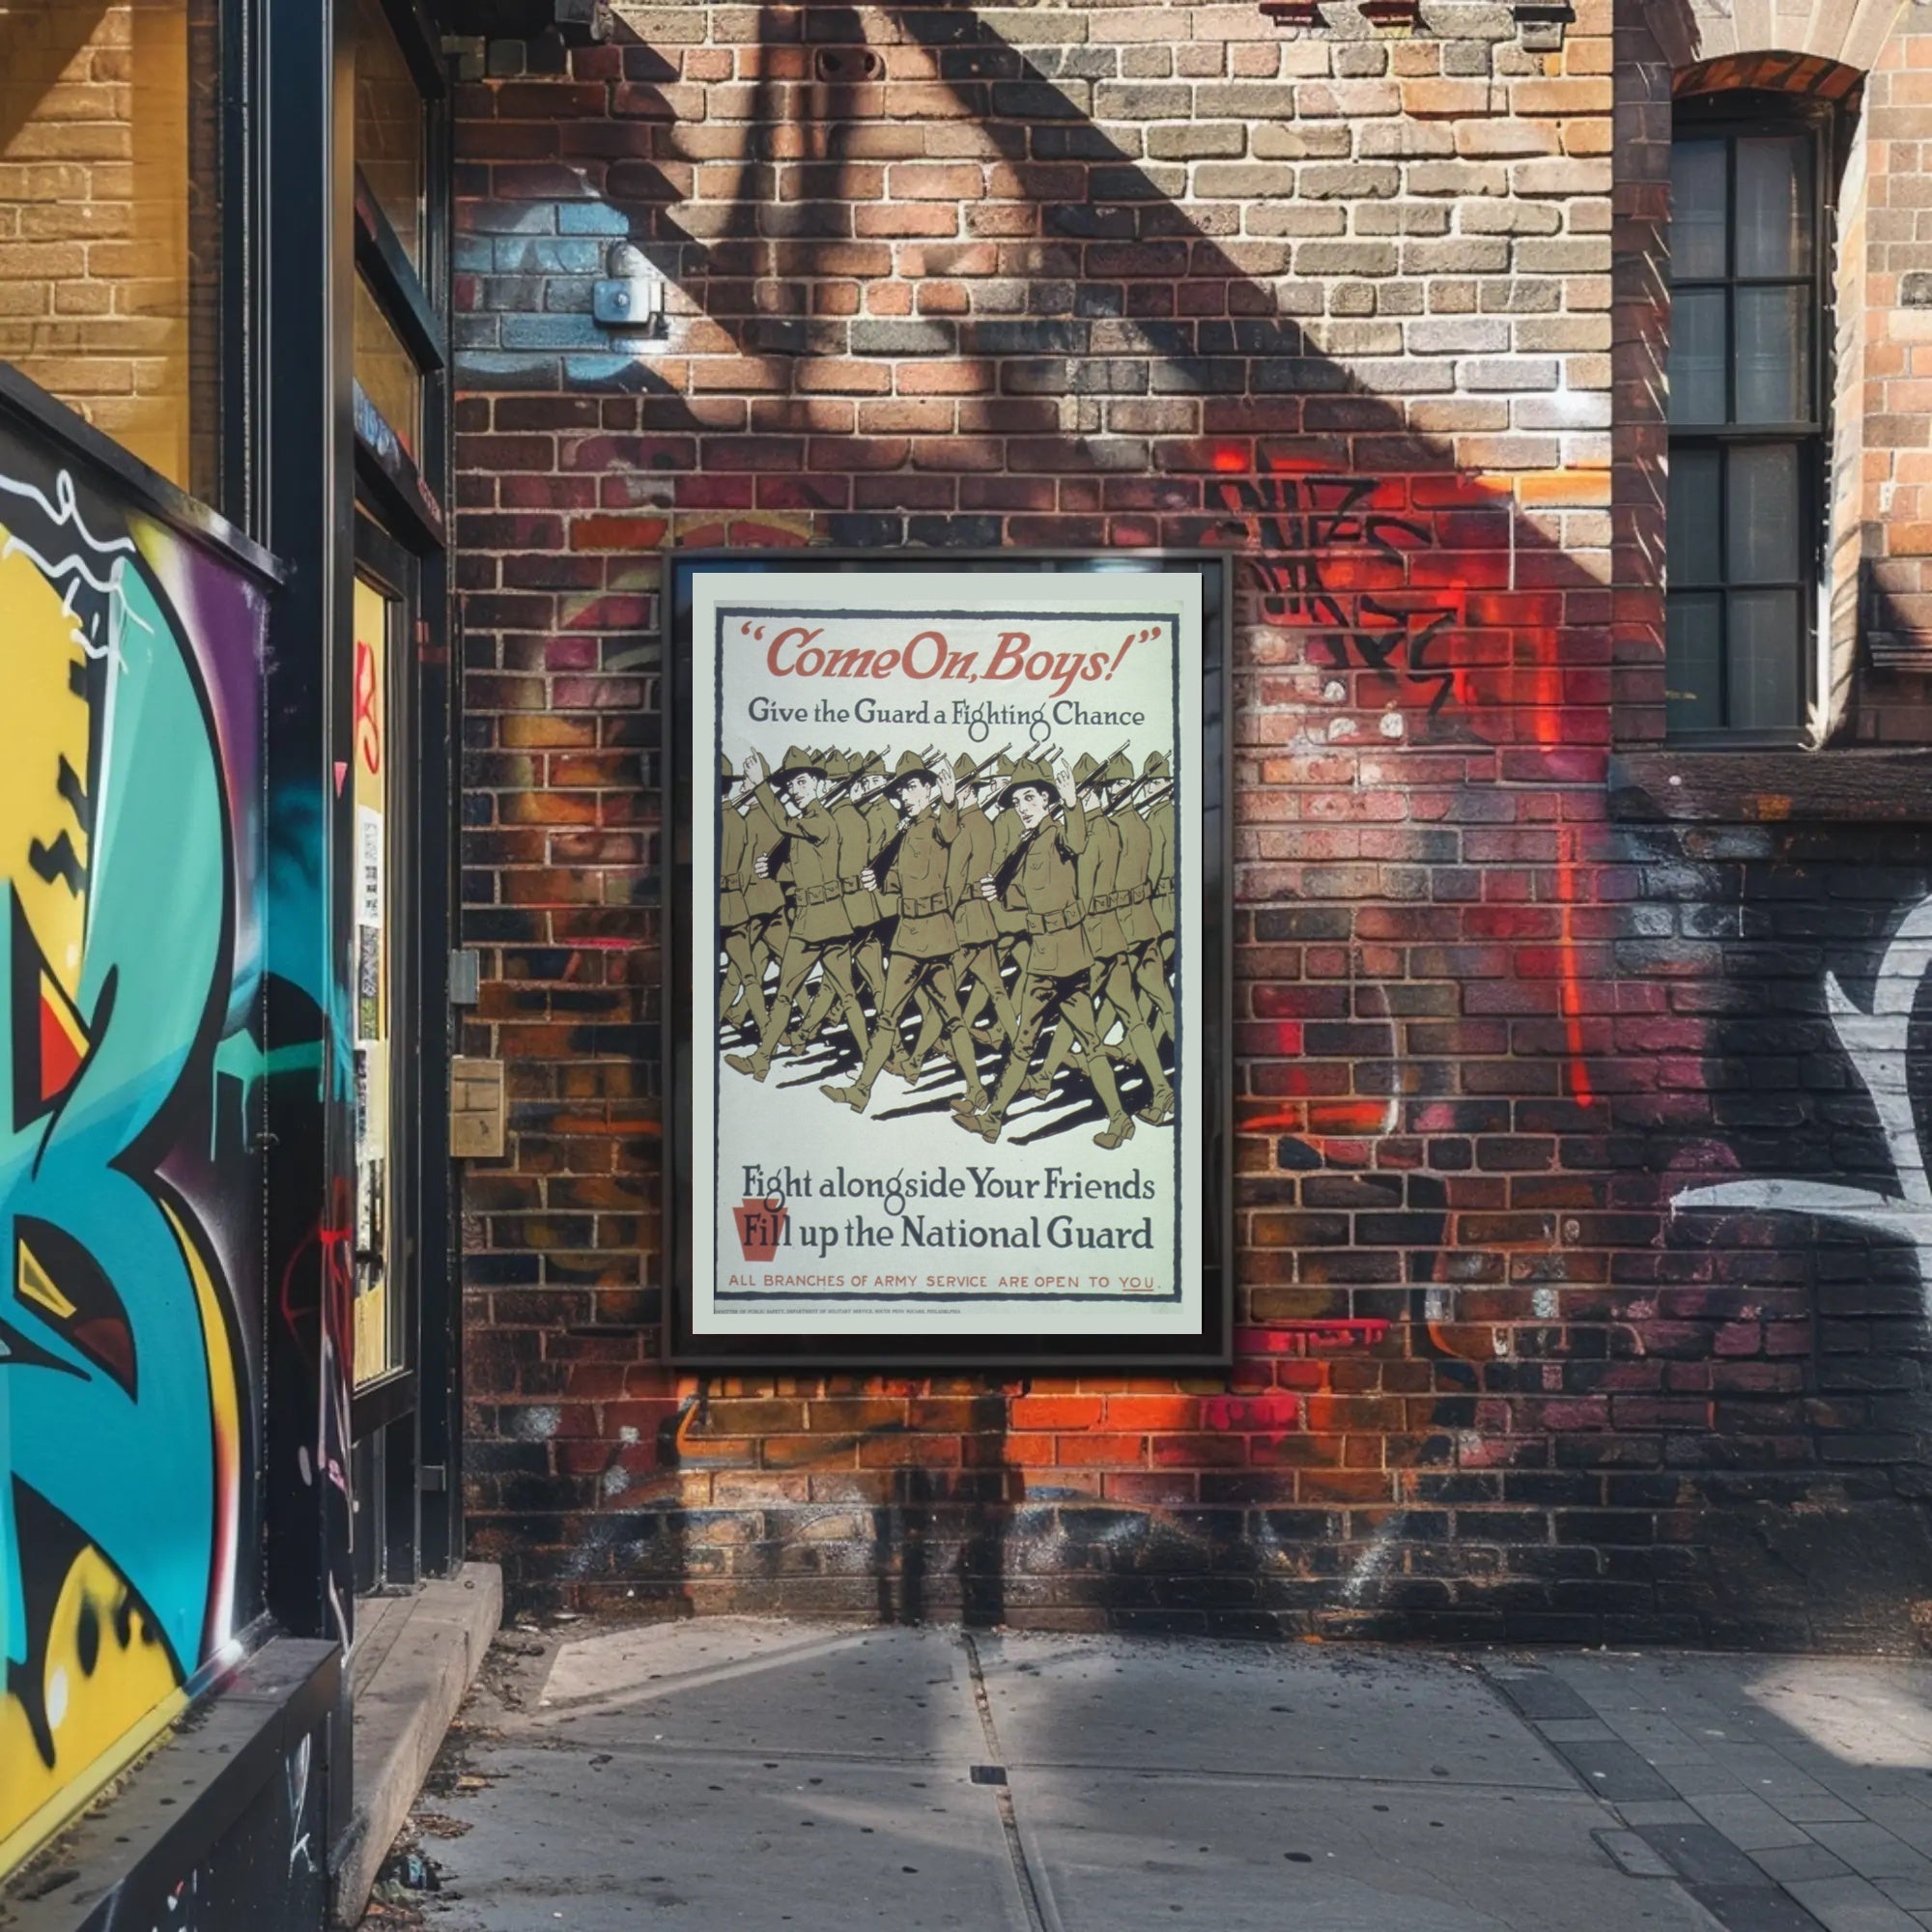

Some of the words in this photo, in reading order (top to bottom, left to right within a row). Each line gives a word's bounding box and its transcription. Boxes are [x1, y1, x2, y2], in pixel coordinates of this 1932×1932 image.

[902, 631, 979, 683] On,
[749, 696, 809, 723] Give
[814, 699, 850, 723] the
[855, 698, 930, 724] Guard
[934, 710, 948, 724] a
[952, 698, 1051, 744] Fighting
[1052, 700, 1146, 725] Chance
[742, 1164, 812, 1213] Fight
[819, 1167, 965, 1216] alongside
[966, 1167, 1039, 1199] Your
[1044, 1167, 1155, 1200] Friends
[743, 1214, 792, 1247] Fill
[799, 1226, 838, 1259] up
[844, 1219, 894, 1247] the
[900, 1214, 1041, 1249] National
[1047, 1215, 1154, 1249] Guard
[728, 1274, 756, 1287] ALL
[764, 1274, 844, 1288] BRANCHES
[851, 1274, 867, 1288] OF
[874, 1275, 917, 1288] ARMY
[926, 1275, 987, 1288] SERVICE
[998, 1276, 1028, 1289] ARE
[1035, 1276, 1079, 1289] OPEN
[1089, 1276, 1110, 1289] TO
